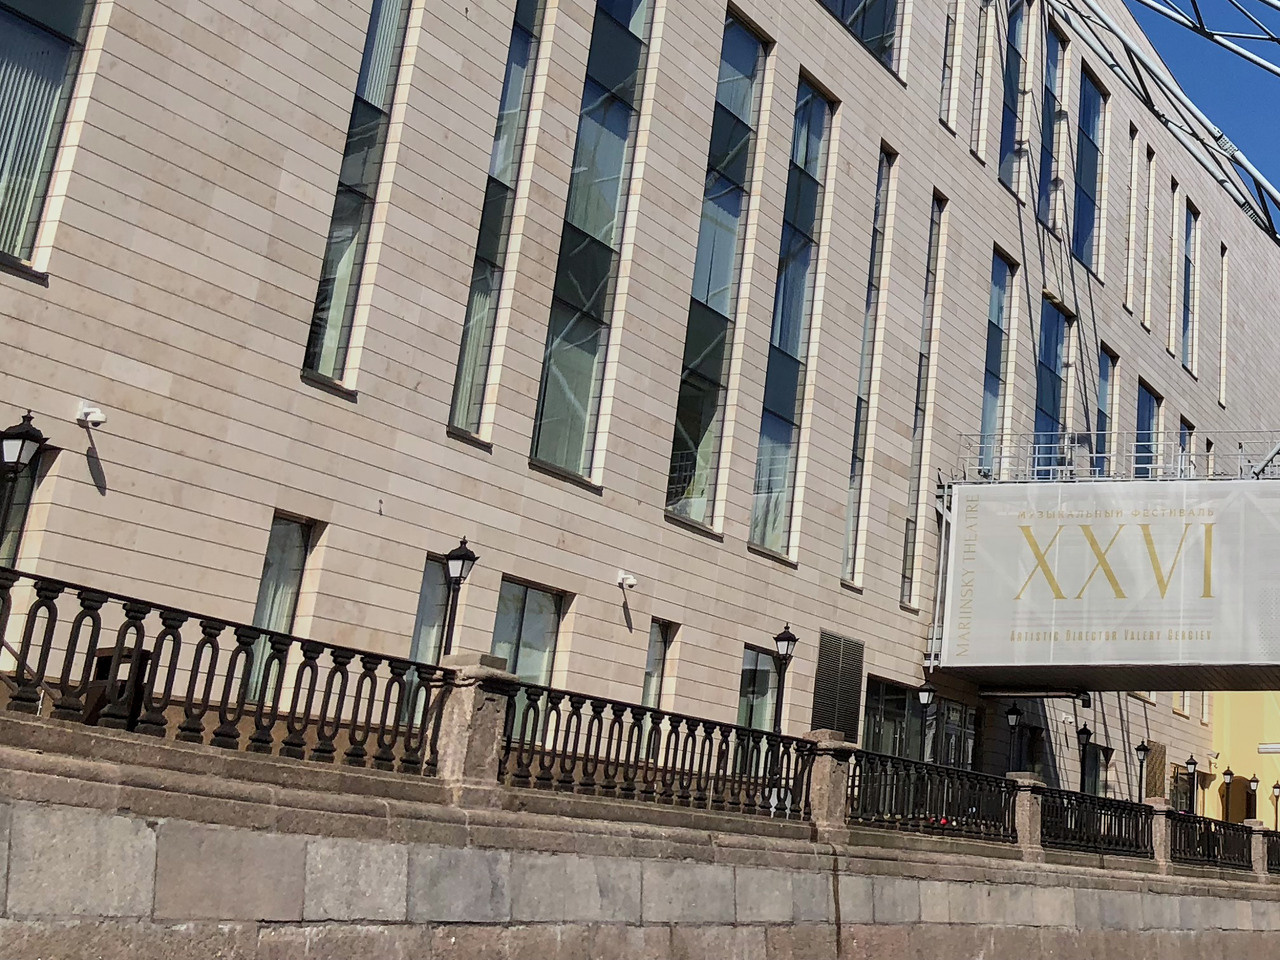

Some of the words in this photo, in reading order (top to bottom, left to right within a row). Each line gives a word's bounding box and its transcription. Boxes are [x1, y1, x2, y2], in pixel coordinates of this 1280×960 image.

[961, 494, 980, 563] THEATRE
[1017, 509, 1124, 521] МУЗЫКАЛЬНЫЙ
[1131, 507, 1216, 519] ФЕСТИВАЛЬ
[1013, 523, 1216, 600] XXVI
[956, 568, 975, 657] MARIINSKY
